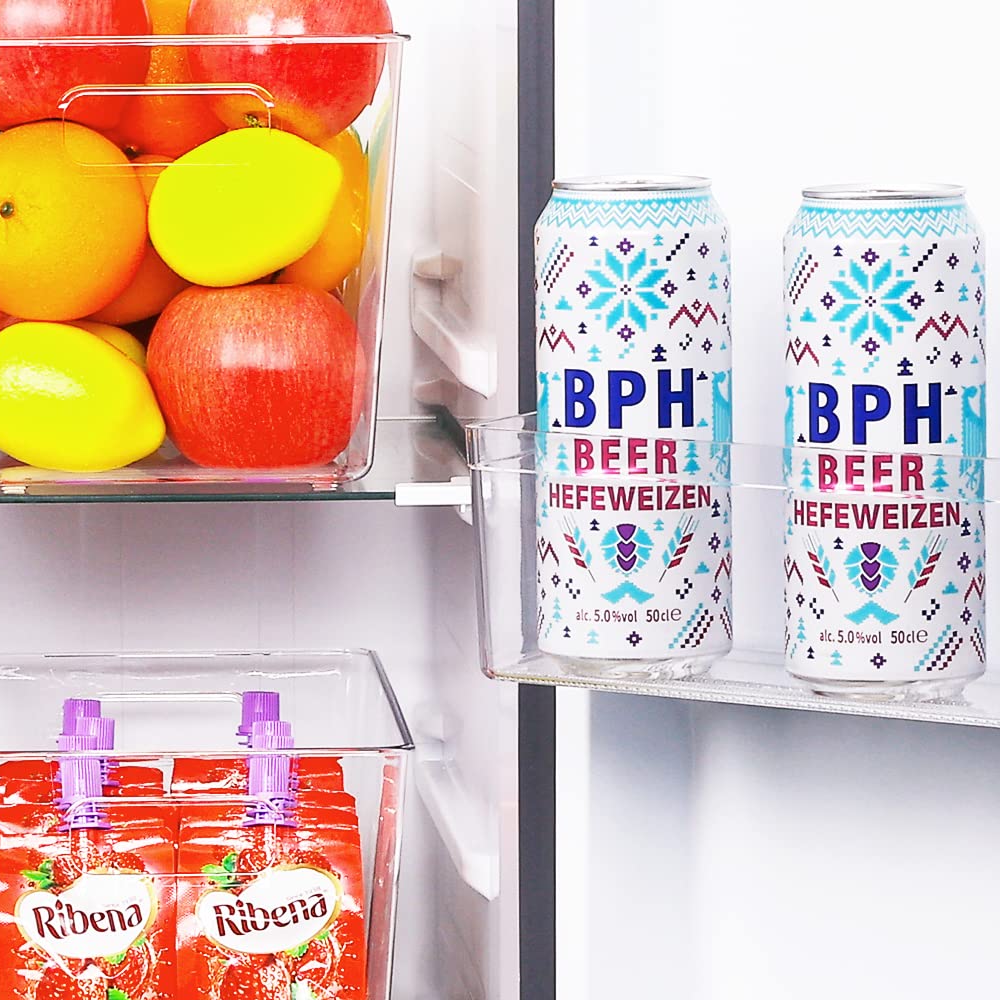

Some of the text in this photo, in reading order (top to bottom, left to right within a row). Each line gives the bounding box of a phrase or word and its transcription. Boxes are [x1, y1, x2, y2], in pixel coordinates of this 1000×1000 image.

[563, 368, 695, 429] BPH
[807, 381, 943, 446] BPH
[573, 438, 678, 476] BEER
[817, 454, 925, 493] BEER
[548, 482, 713, 512] HEFEWEIZEN
[793, 499, 962, 530] HEFEWEIZEN
[819, 629, 835, 642] alc.
[32, 899, 143, 940] Ribena
[213, 893, 328, 937] Ribena
